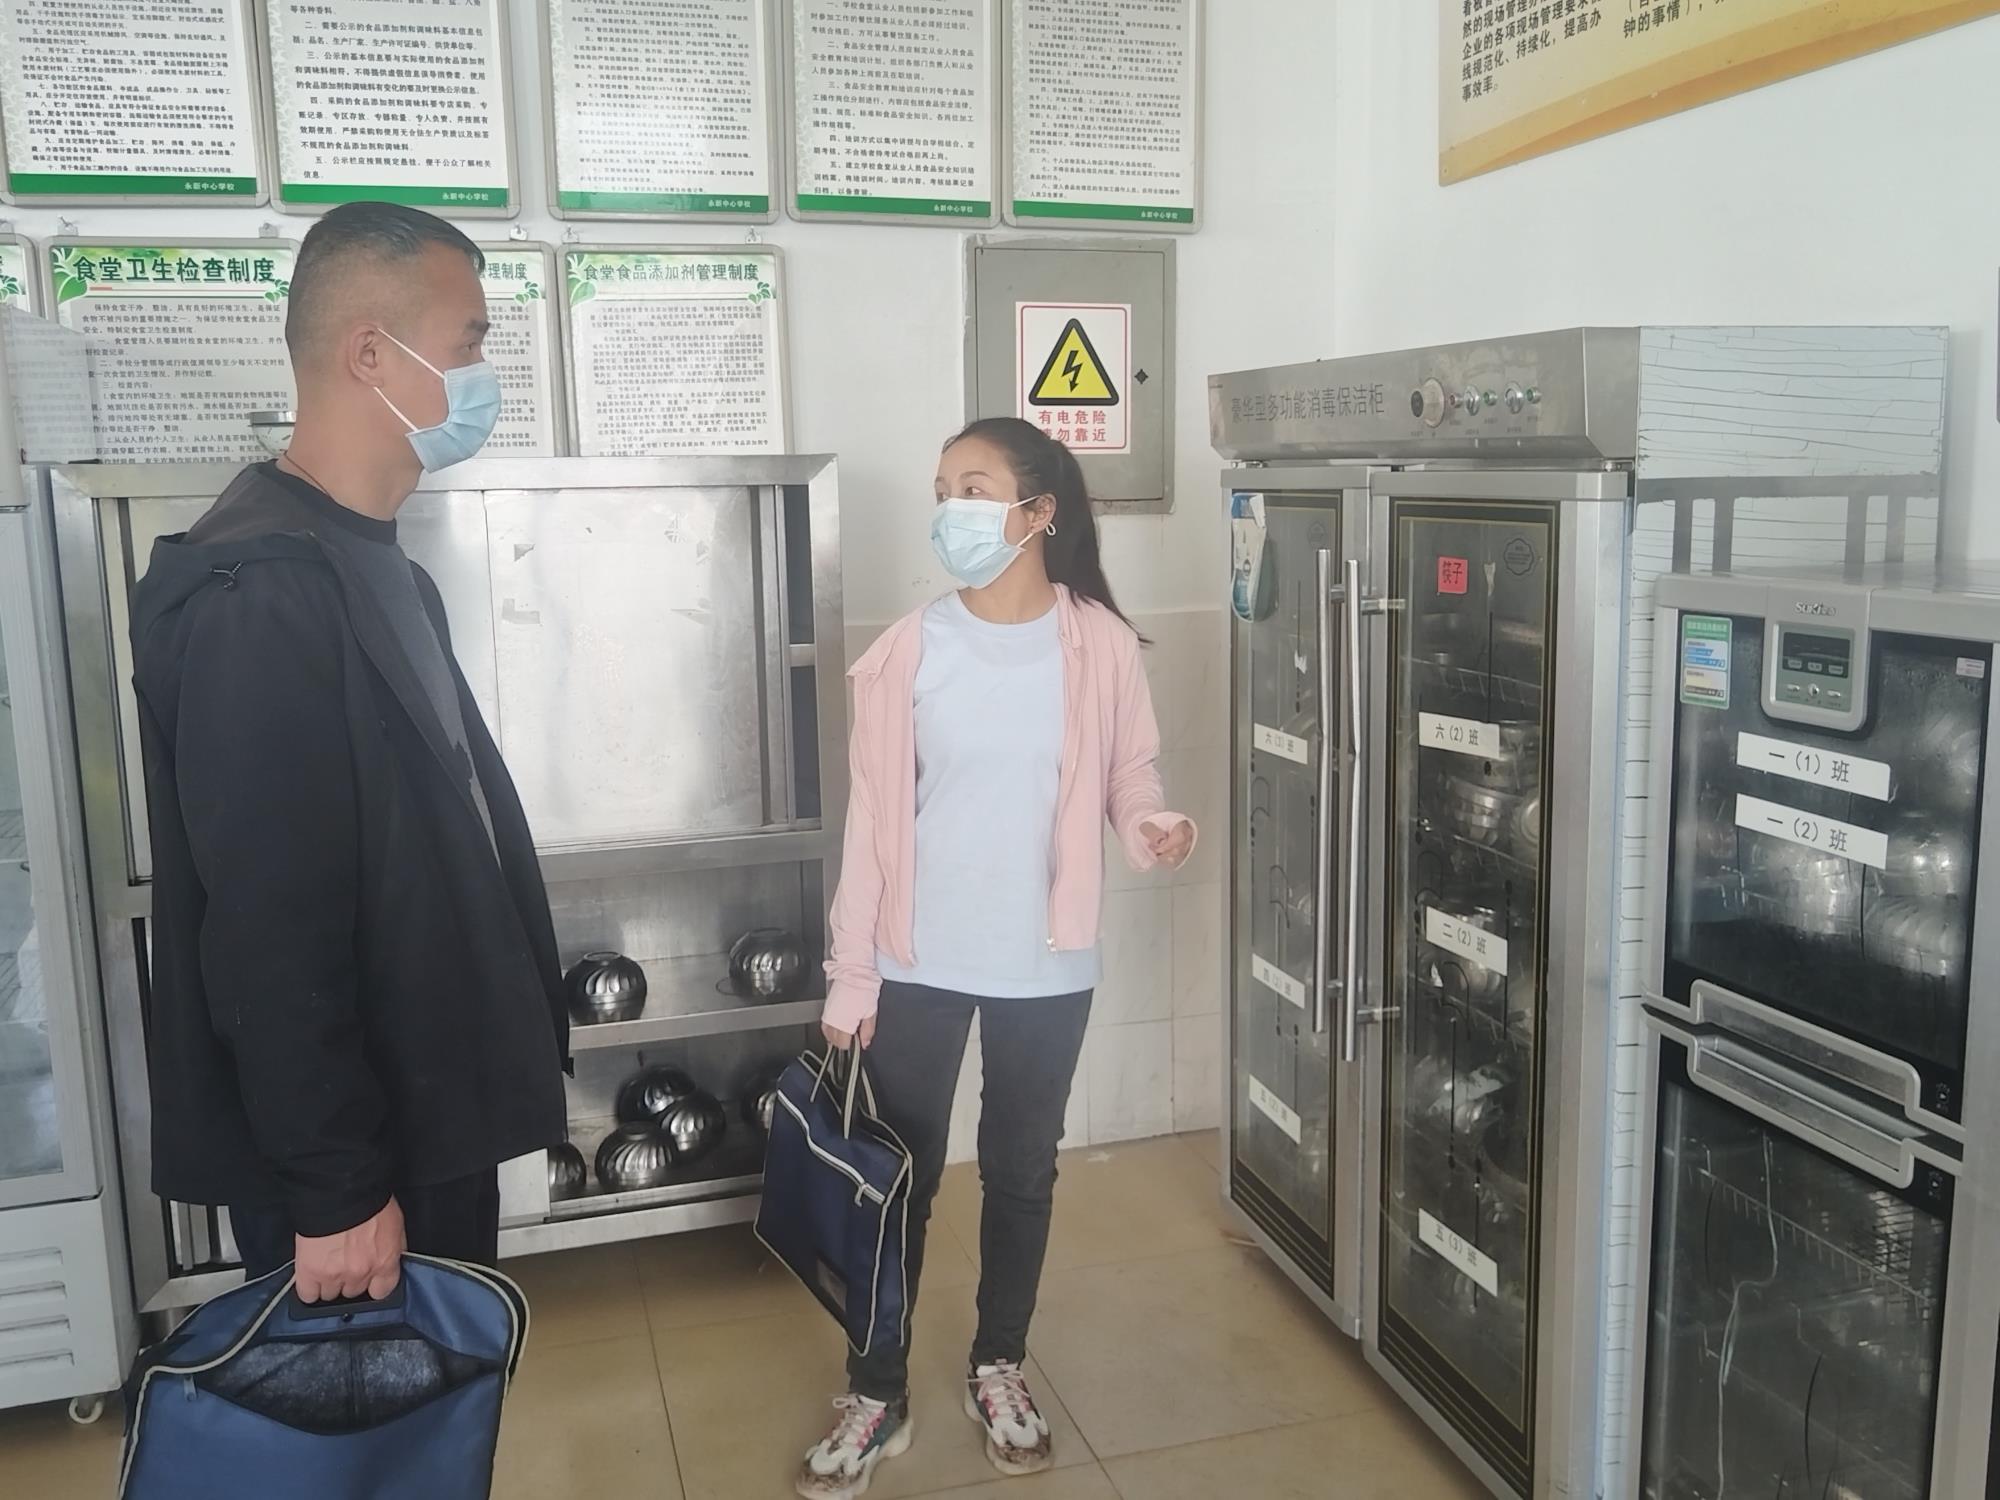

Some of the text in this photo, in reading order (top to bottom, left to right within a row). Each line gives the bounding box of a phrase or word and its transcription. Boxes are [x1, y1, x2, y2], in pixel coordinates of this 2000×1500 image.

[73, 256, 276, 282] 食堂卫生检查制度
[478, 261, 528, 281] 理制度
[584, 262, 760, 281] 食堂食品添加剂管理制度
[1232, 384, 1385, 423] 豪华型多功能消毒保洁柜
[1038, 410, 1106, 425] 有电危险
